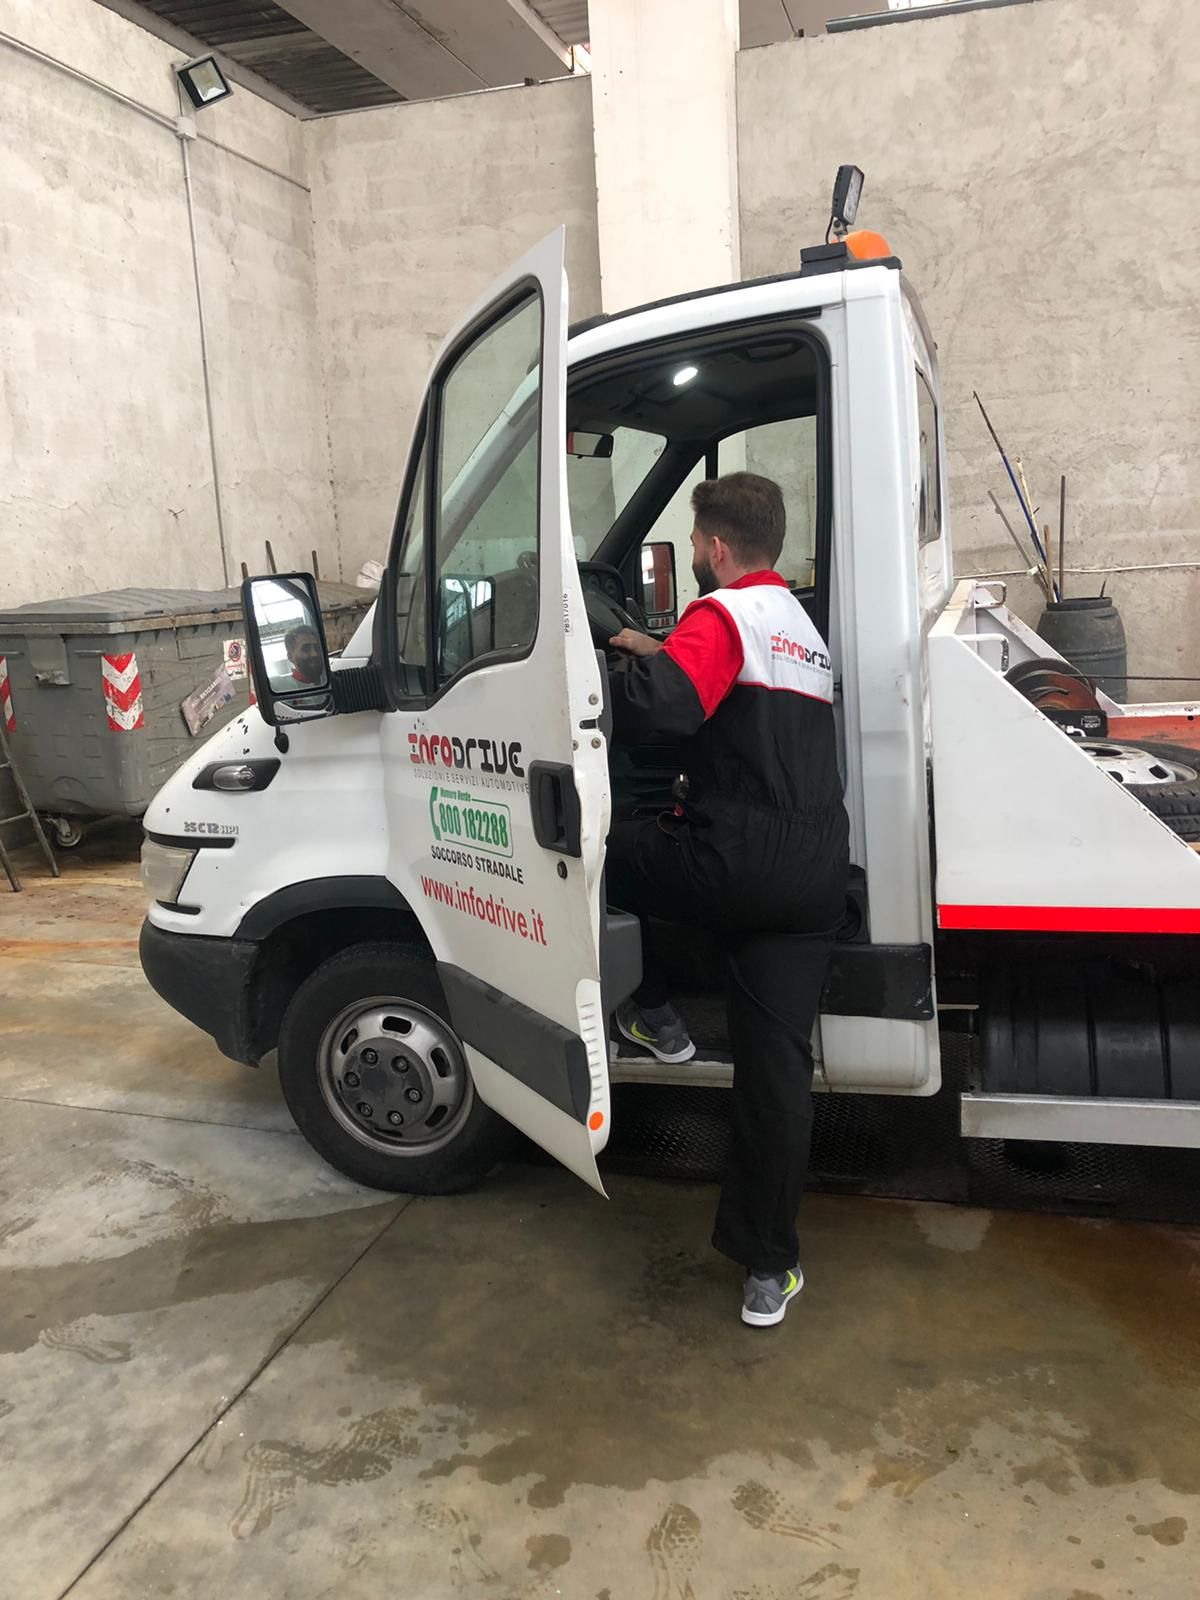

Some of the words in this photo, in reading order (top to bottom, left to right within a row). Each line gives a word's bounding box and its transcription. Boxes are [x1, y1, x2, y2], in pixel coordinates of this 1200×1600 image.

[481, 777, 530, 794] AUTOMOTIVE
[439, 802, 462, 837] 800
[462, 808, 508, 847] 182288
[431, 845, 473, 869] SOCCORSO
[475, 856, 524, 885] STRADALE
[421, 875, 547, 946] www.infodrive.it
